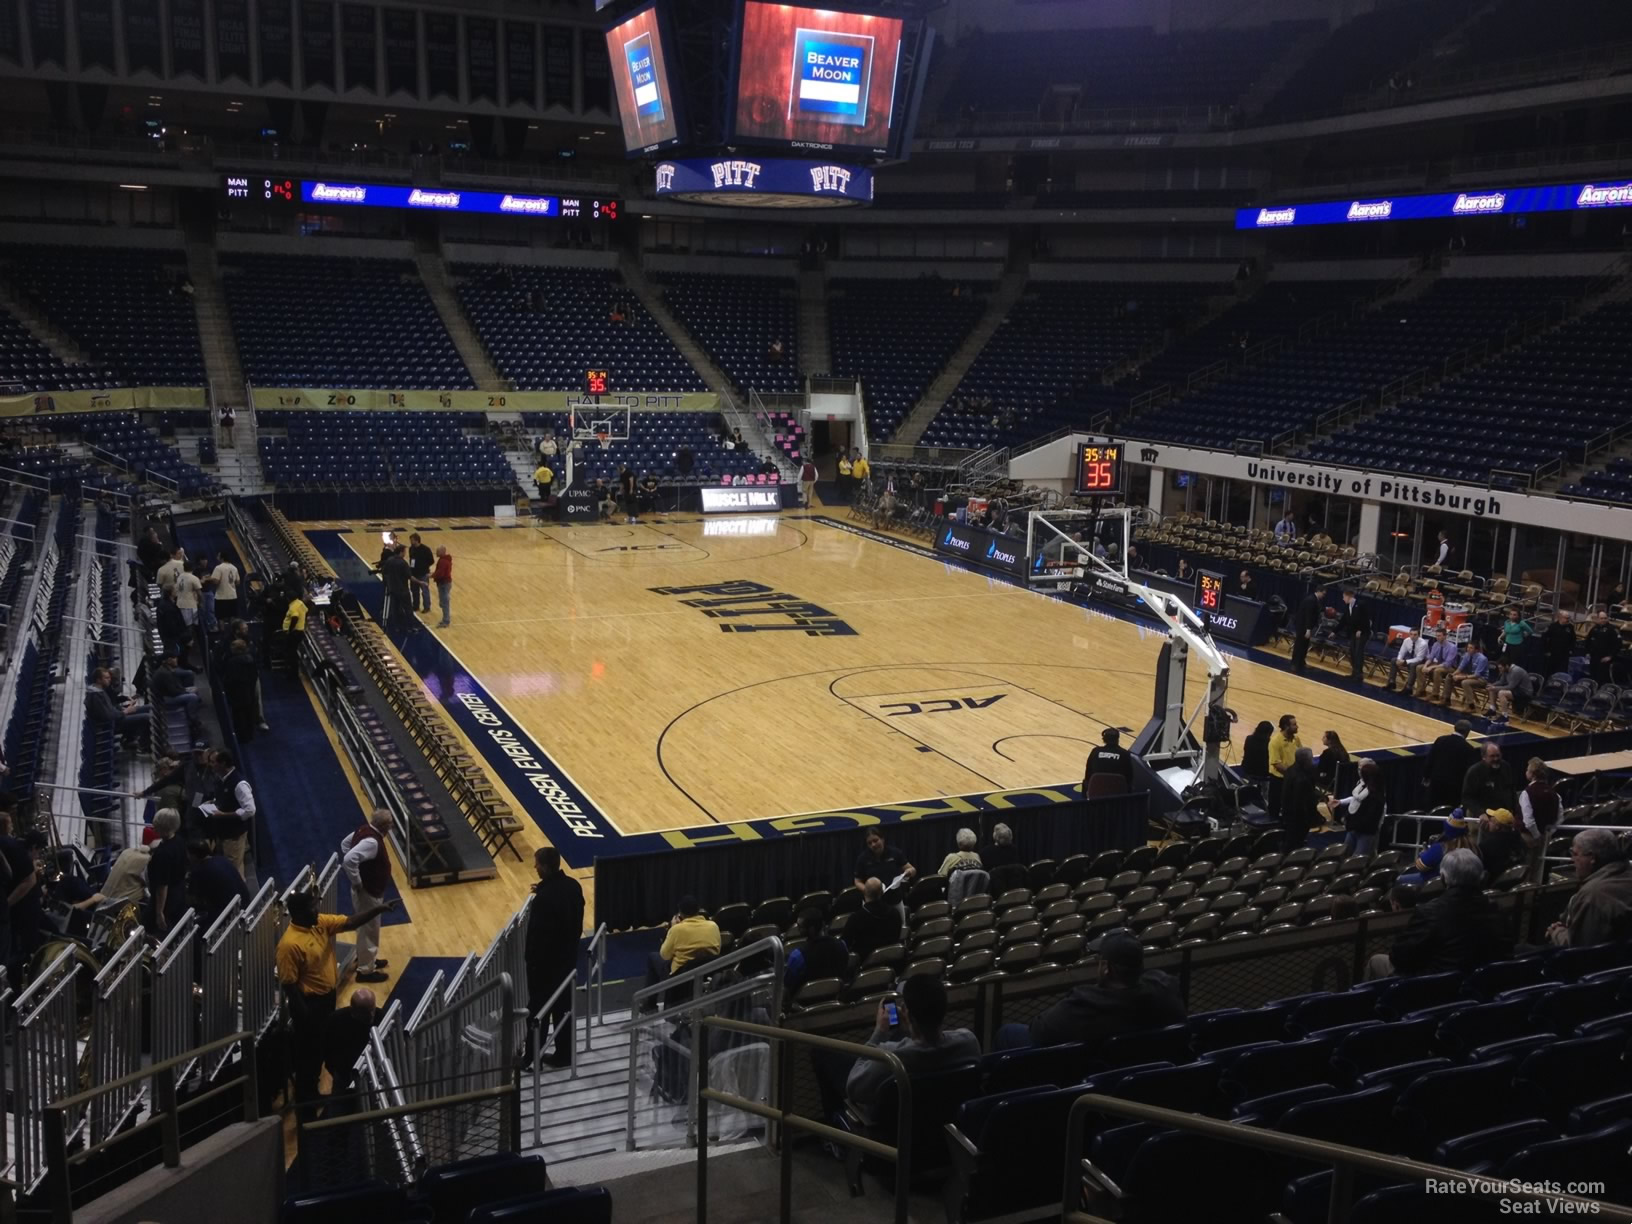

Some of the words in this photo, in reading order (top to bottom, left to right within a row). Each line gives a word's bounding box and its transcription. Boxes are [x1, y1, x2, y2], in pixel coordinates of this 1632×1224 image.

[631, 56, 651, 73] BEAVER
[807, 52, 860, 69] BEAVER
[636, 71, 652, 85] MOON
[812, 66, 852, 82] MOON
[791, 140, 833, 150] DAKTRONICS
[711, 160, 760, 188] PITT
[810, 165, 851, 193] PITT
[228, 178, 248, 187] MAN
[265, 180, 271, 188] 0
[284, 181, 291, 189] 0
[228, 188, 248, 197] PITT
[265, 190, 272, 198] 0
[285, 191, 292, 199] 0
[312, 183, 366, 200] Aaron's
[408, 189, 460, 206] Aaron's
[500, 195, 550, 212] Aaron's
[562, 199, 580, 207] MAN
[593, 201, 599, 209] 0
[1347, 201, 1392, 219] Aaron's
[1453, 193, 1505, 211] Aaron's
[562, 209, 580, 217] PITT
[593, 210, 599, 219] 0
[610, 211, 617, 220] 0
[1256, 208, 1296, 224] Aaron's
[590, 378, 604, 392] 35
[614, 396, 639, 407] TO
[645, 396, 683, 408] PITT
[1085, 447, 1117, 462] 35:14
[1087, 462, 1111, 487] 35
[568, 490, 591, 498] UPMC
[1246, 461, 1343, 494] University
[1351, 478, 1372, 495] of
[1379, 481, 1501, 516] Pittsburgh
[748, 491, 777, 506] MILK
[575, 505, 591, 513] PNC
[949, 536, 970, 550] PEOPLES
[993, 549, 1016, 564] PEOPLES
[1201, 576, 1220, 591] 35:14
[1203, 590, 1217, 607] 35
[645, 579, 860, 637] PITT
[456, 692, 503, 727] CENTER
[879, 693, 1009, 717] ACC
[487, 729, 543, 770] EVENTS
[524, 772, 605, 838] PETERSEN
